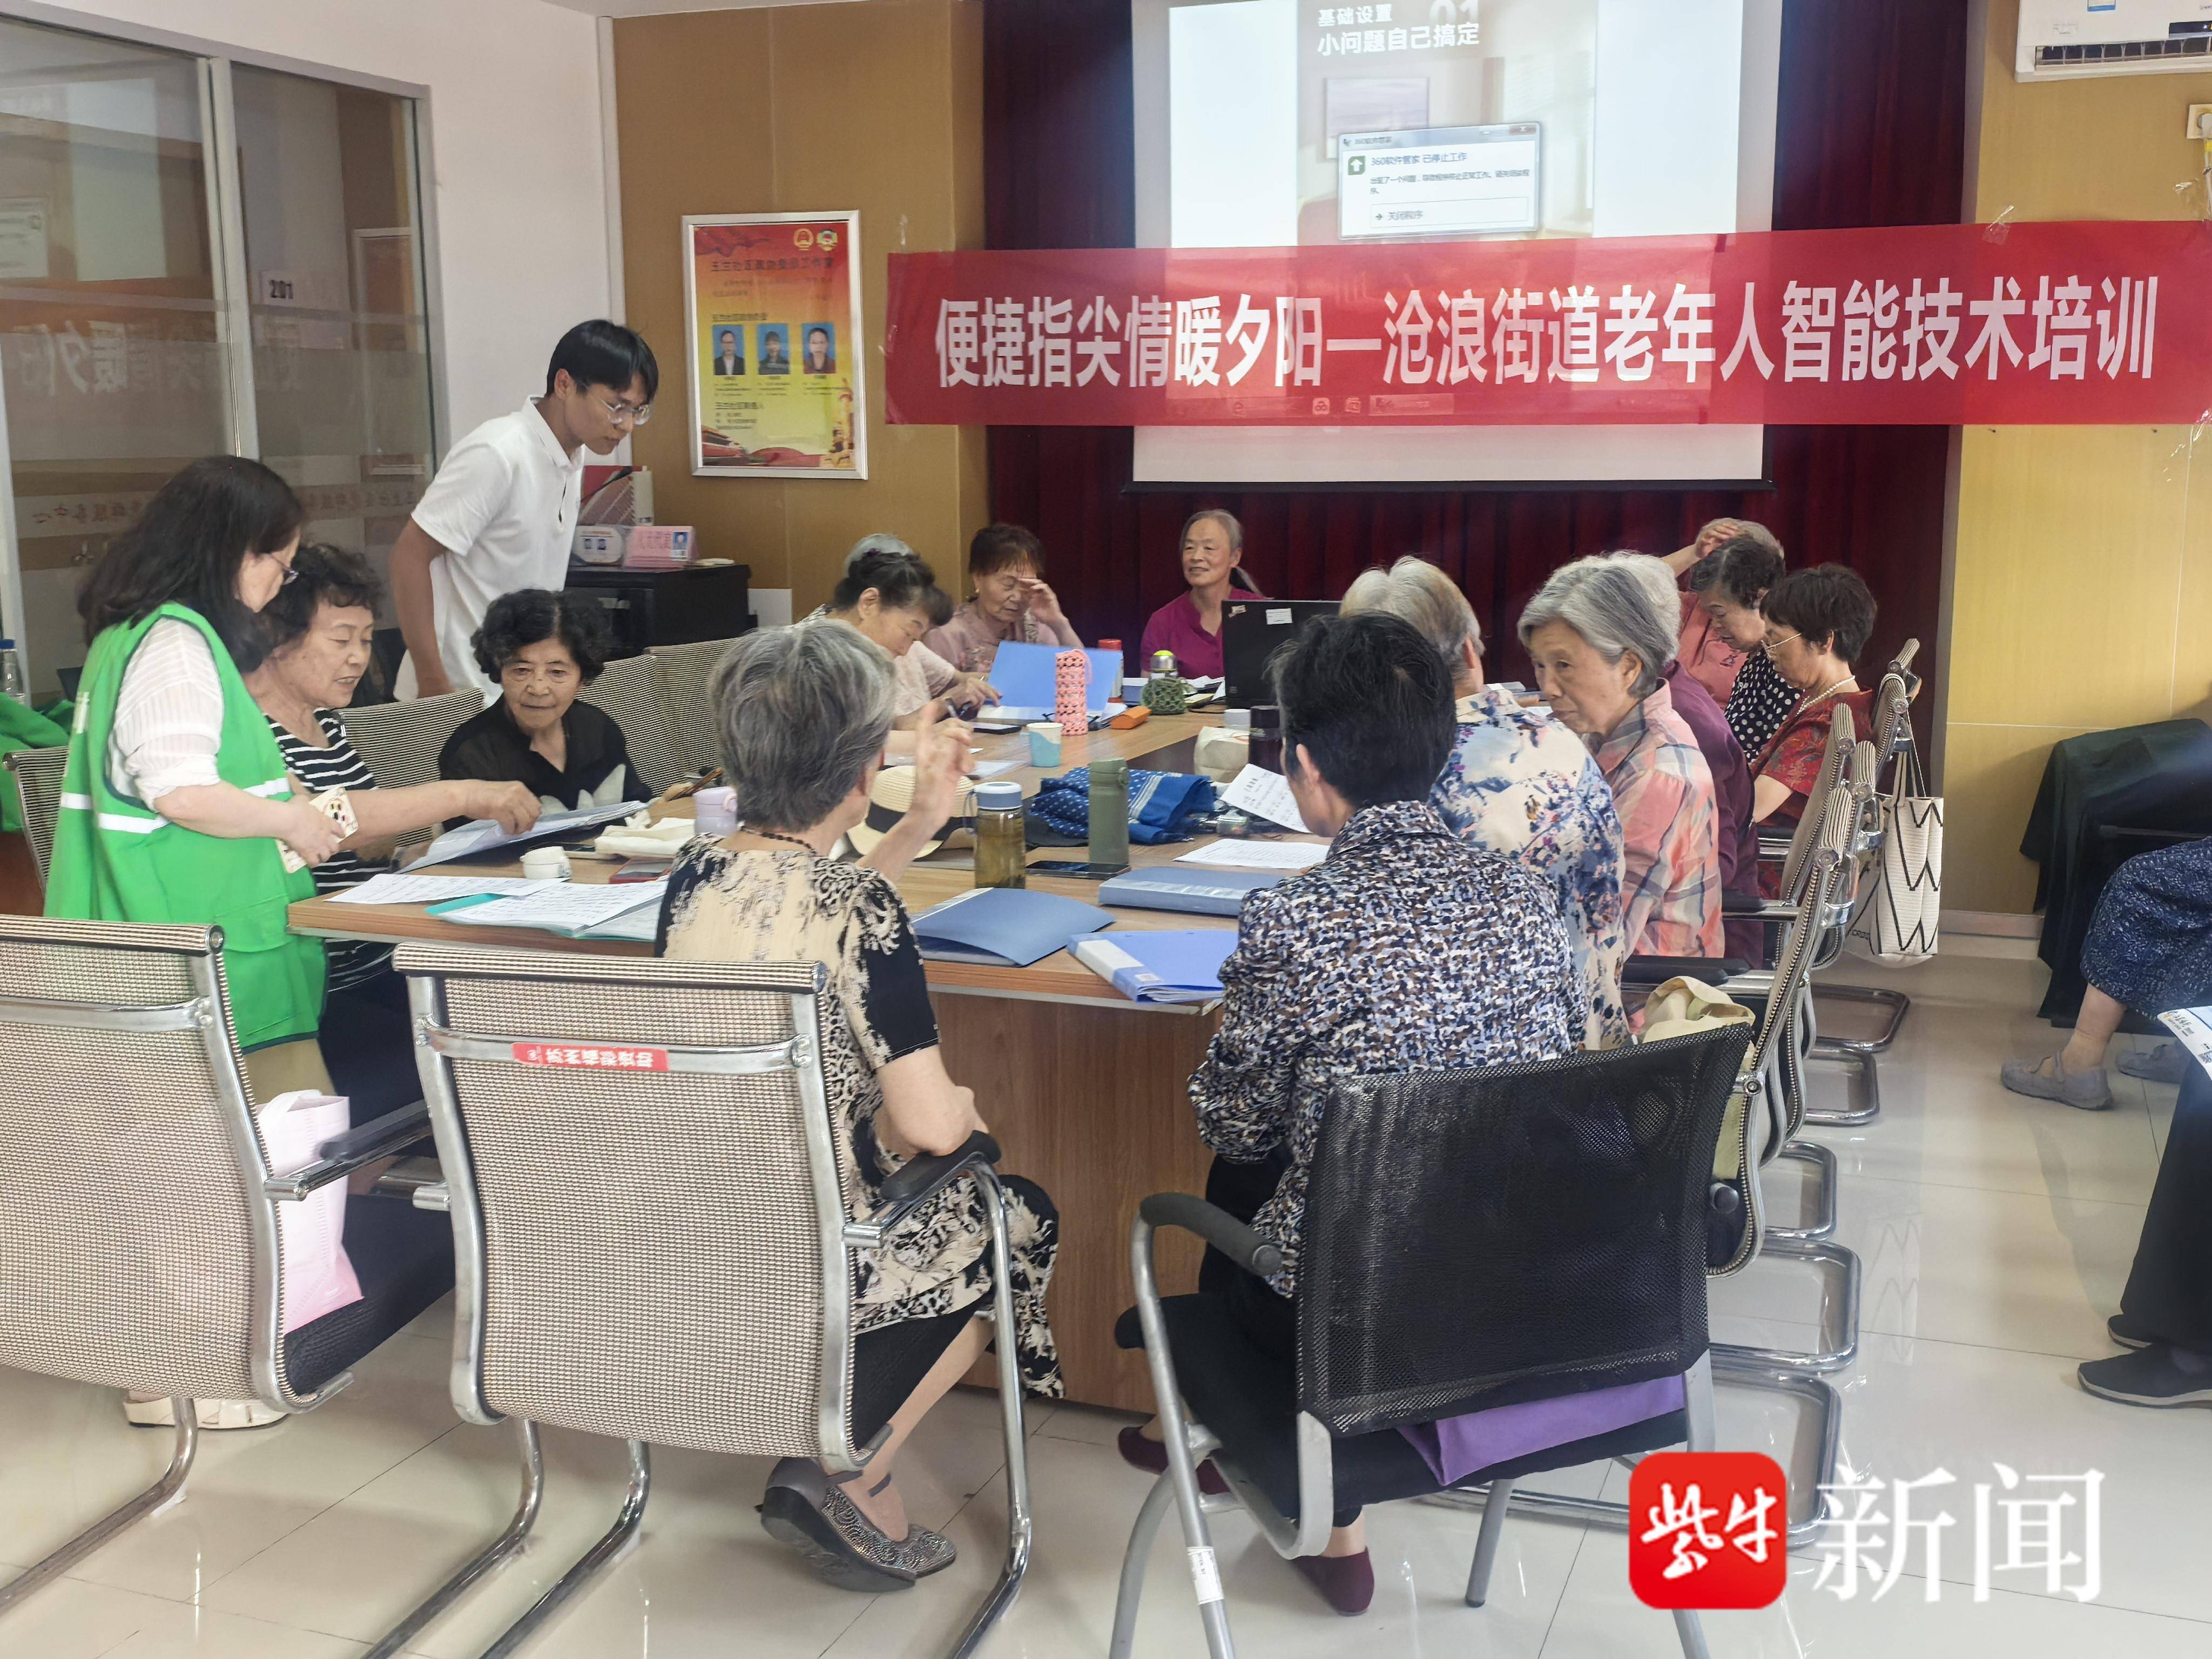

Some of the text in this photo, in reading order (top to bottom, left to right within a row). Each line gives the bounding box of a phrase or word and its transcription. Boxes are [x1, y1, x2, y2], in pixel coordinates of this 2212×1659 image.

[1318, 4, 1393, 27] 基础设置
[1318, 22, 1480, 56] 小问题自己搞定
